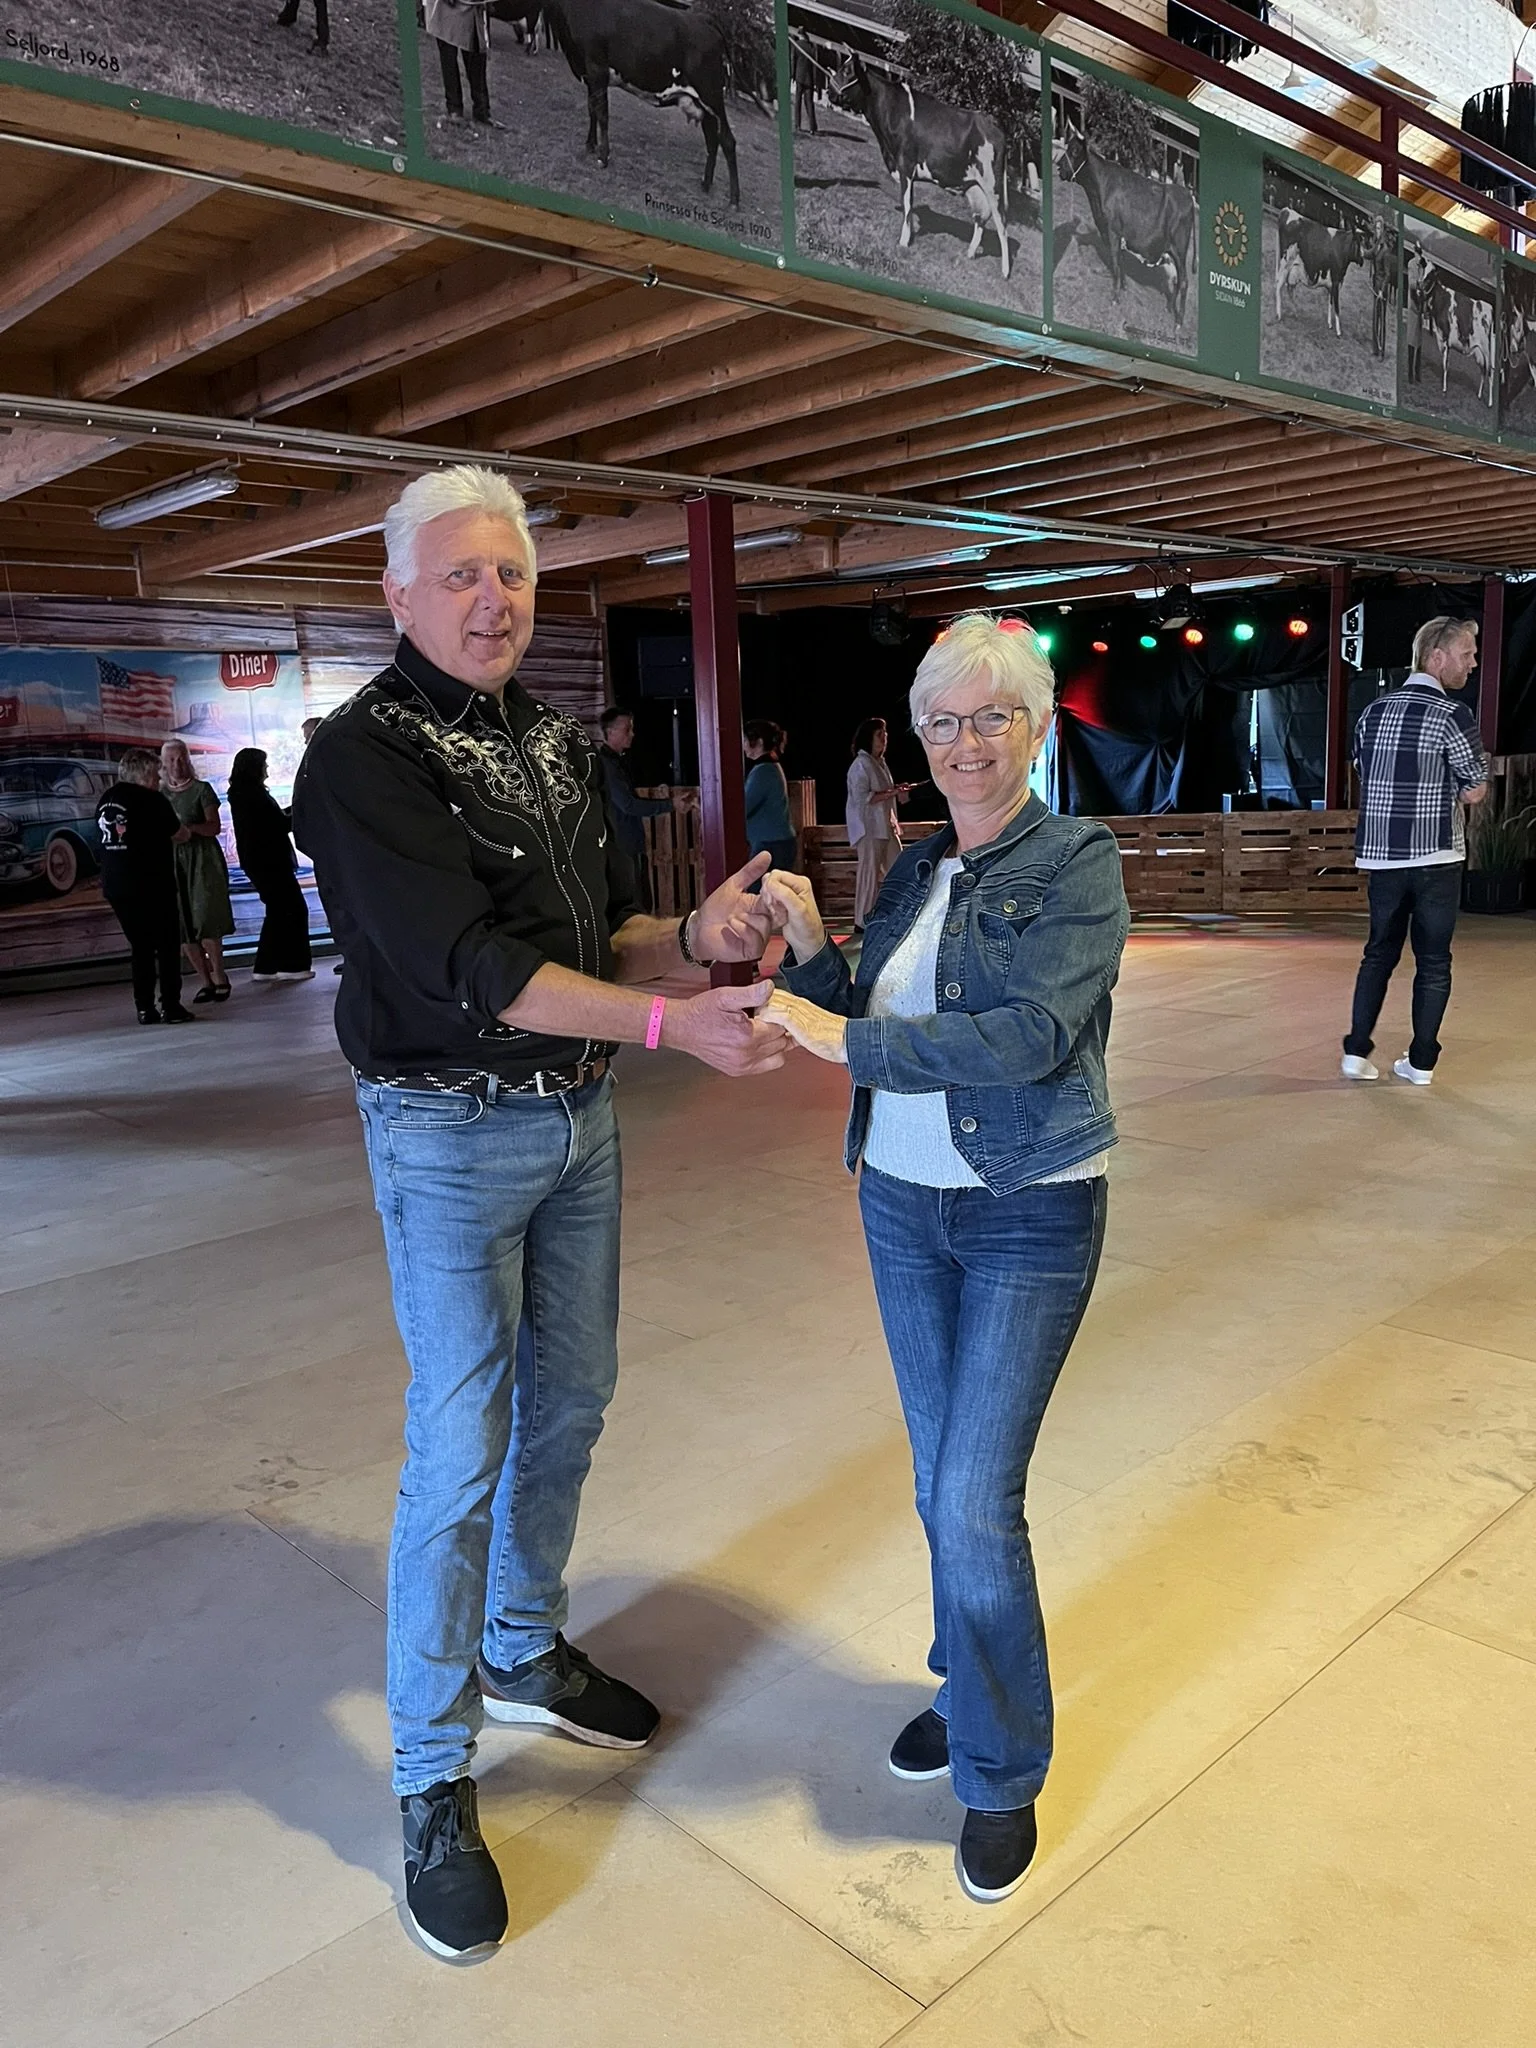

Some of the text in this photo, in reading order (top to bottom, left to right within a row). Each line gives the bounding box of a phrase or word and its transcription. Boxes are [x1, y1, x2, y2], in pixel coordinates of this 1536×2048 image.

[5, 28, 120, 73] Seljord, 1968
[749, 222, 772, 240] 1970
[229, 653, 268, 679] Diner
